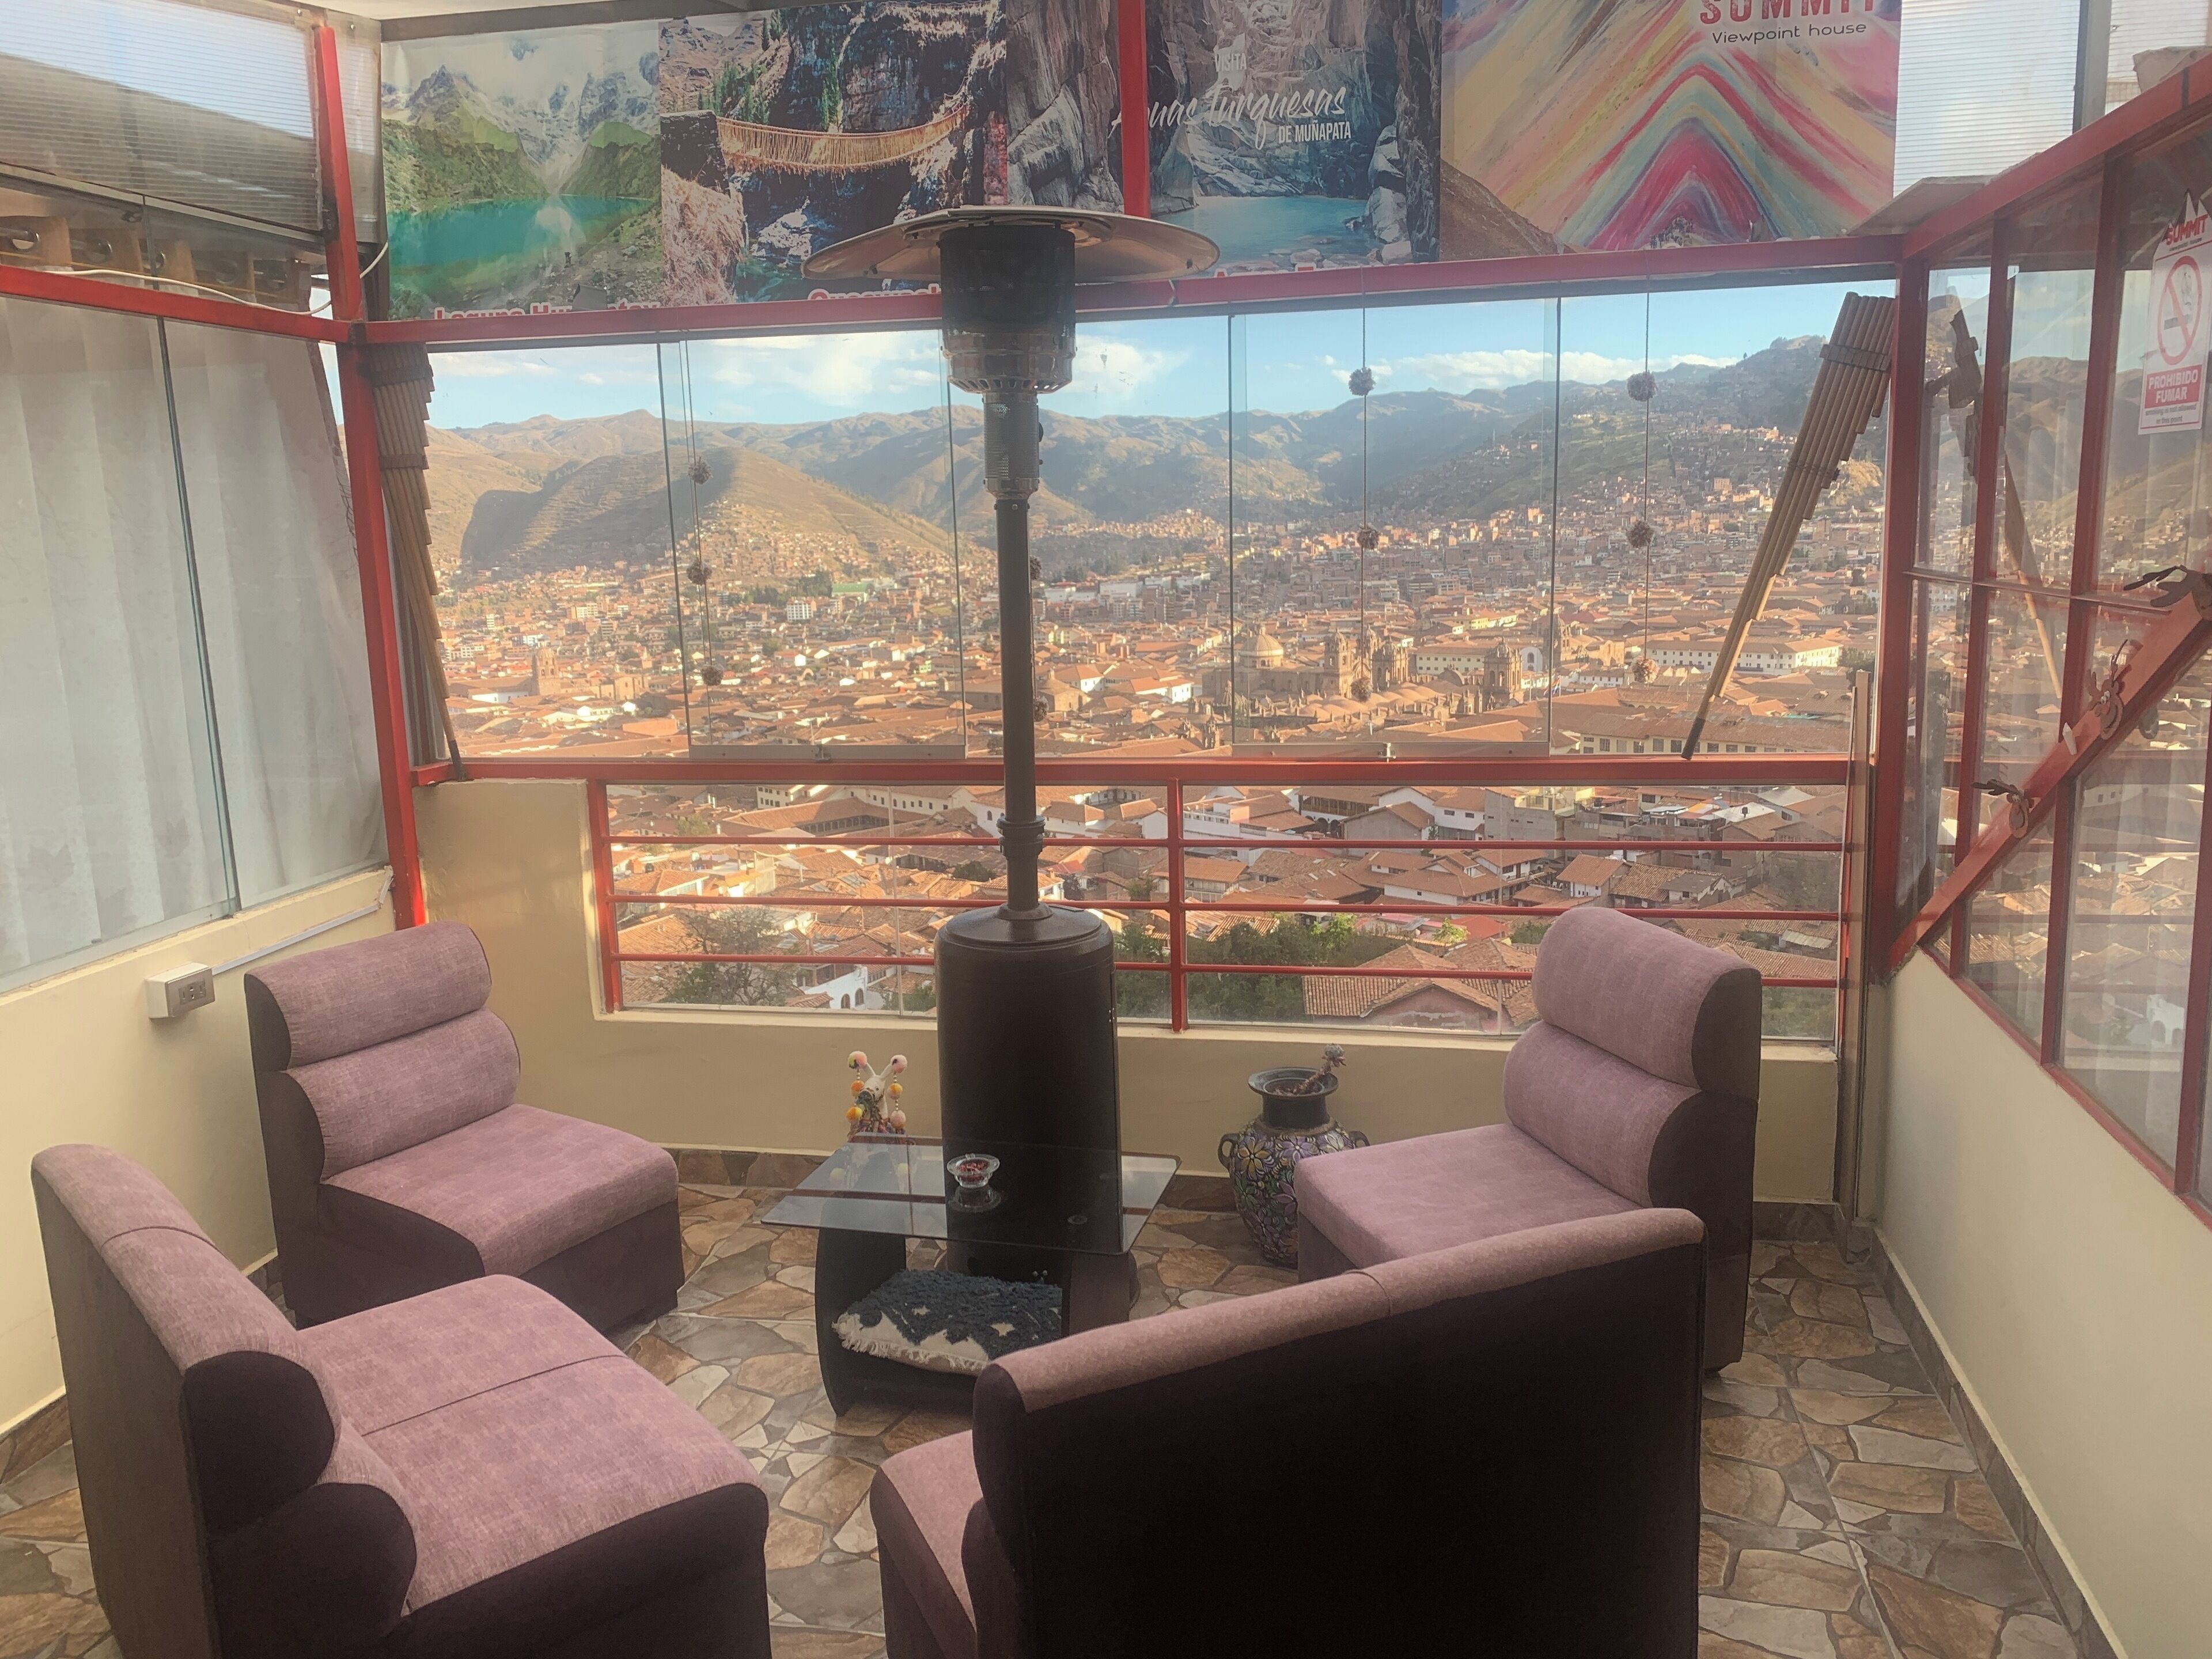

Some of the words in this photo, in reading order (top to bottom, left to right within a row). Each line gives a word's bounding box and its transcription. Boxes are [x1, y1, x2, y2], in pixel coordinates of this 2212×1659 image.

[1712, 25, 1801, 45] Viewpoint
[1809, 24, 1867, 36] house
[1214, 52, 1247, 72] VISITA
[1205, 85, 1347, 150] Turquesas
[1278, 124, 1292, 144] DE
[1295, 120, 1351, 143] MUÑAPATA
[2166, 213, 2209, 246] SUMMIT
[2148, 369, 2199, 390] PROHIBIDO
[2156, 387, 2188, 403] FUMAR
